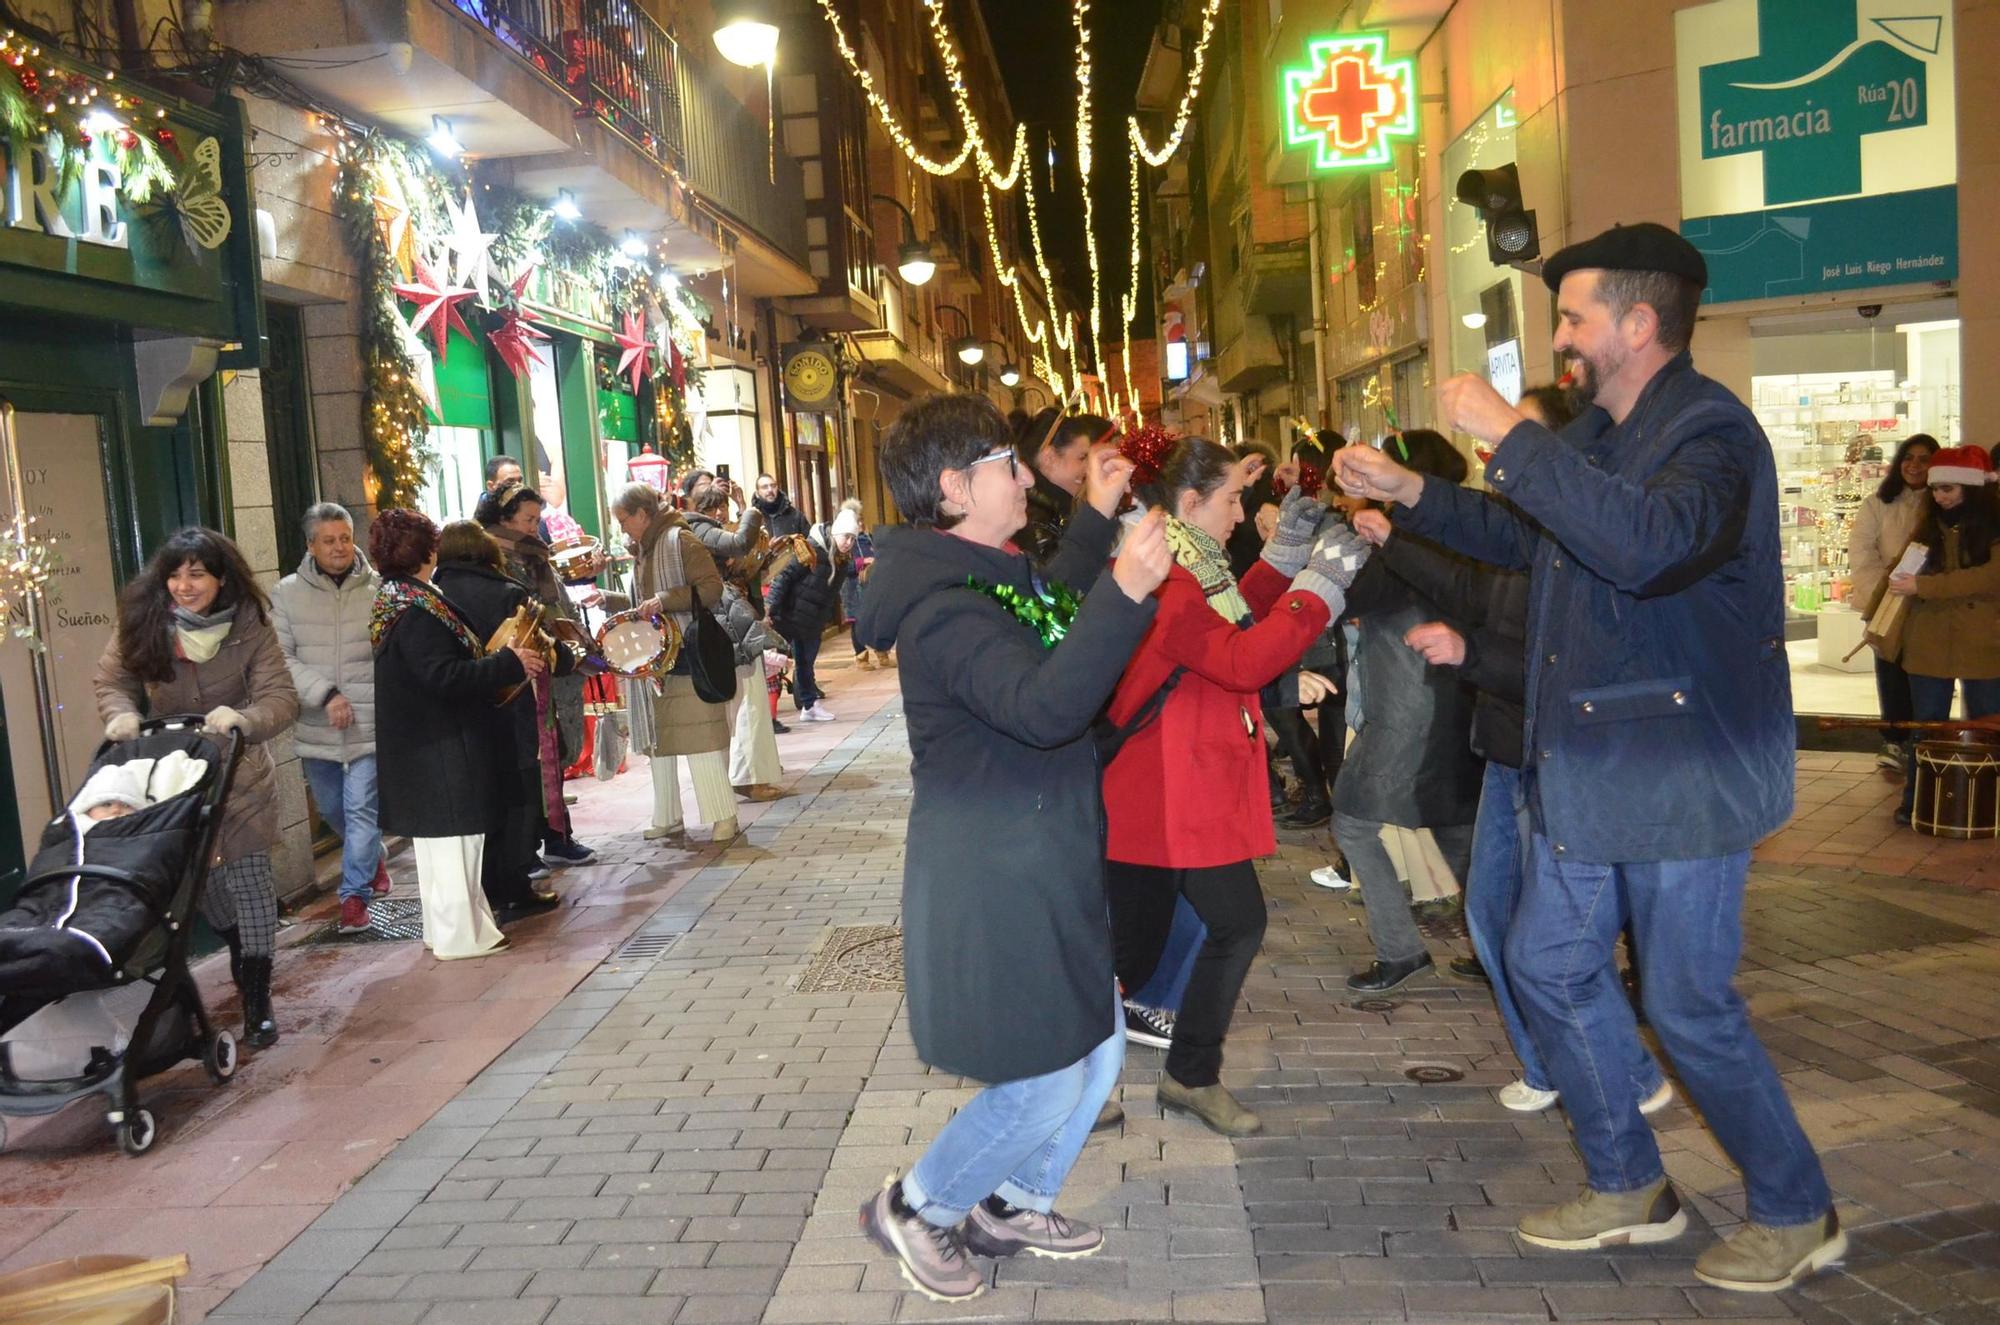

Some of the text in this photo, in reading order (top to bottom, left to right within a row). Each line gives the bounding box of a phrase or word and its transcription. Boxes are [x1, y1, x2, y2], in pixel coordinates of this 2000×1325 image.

[1858, 76, 1919, 123] Rúa 20
[1710, 100, 1832, 150] farmacia
[1822, 255, 1944, 280] José Luis Riego Hernández
[789, 356, 829, 377] SONIDO
[56, 607, 110, 628] Sueños
